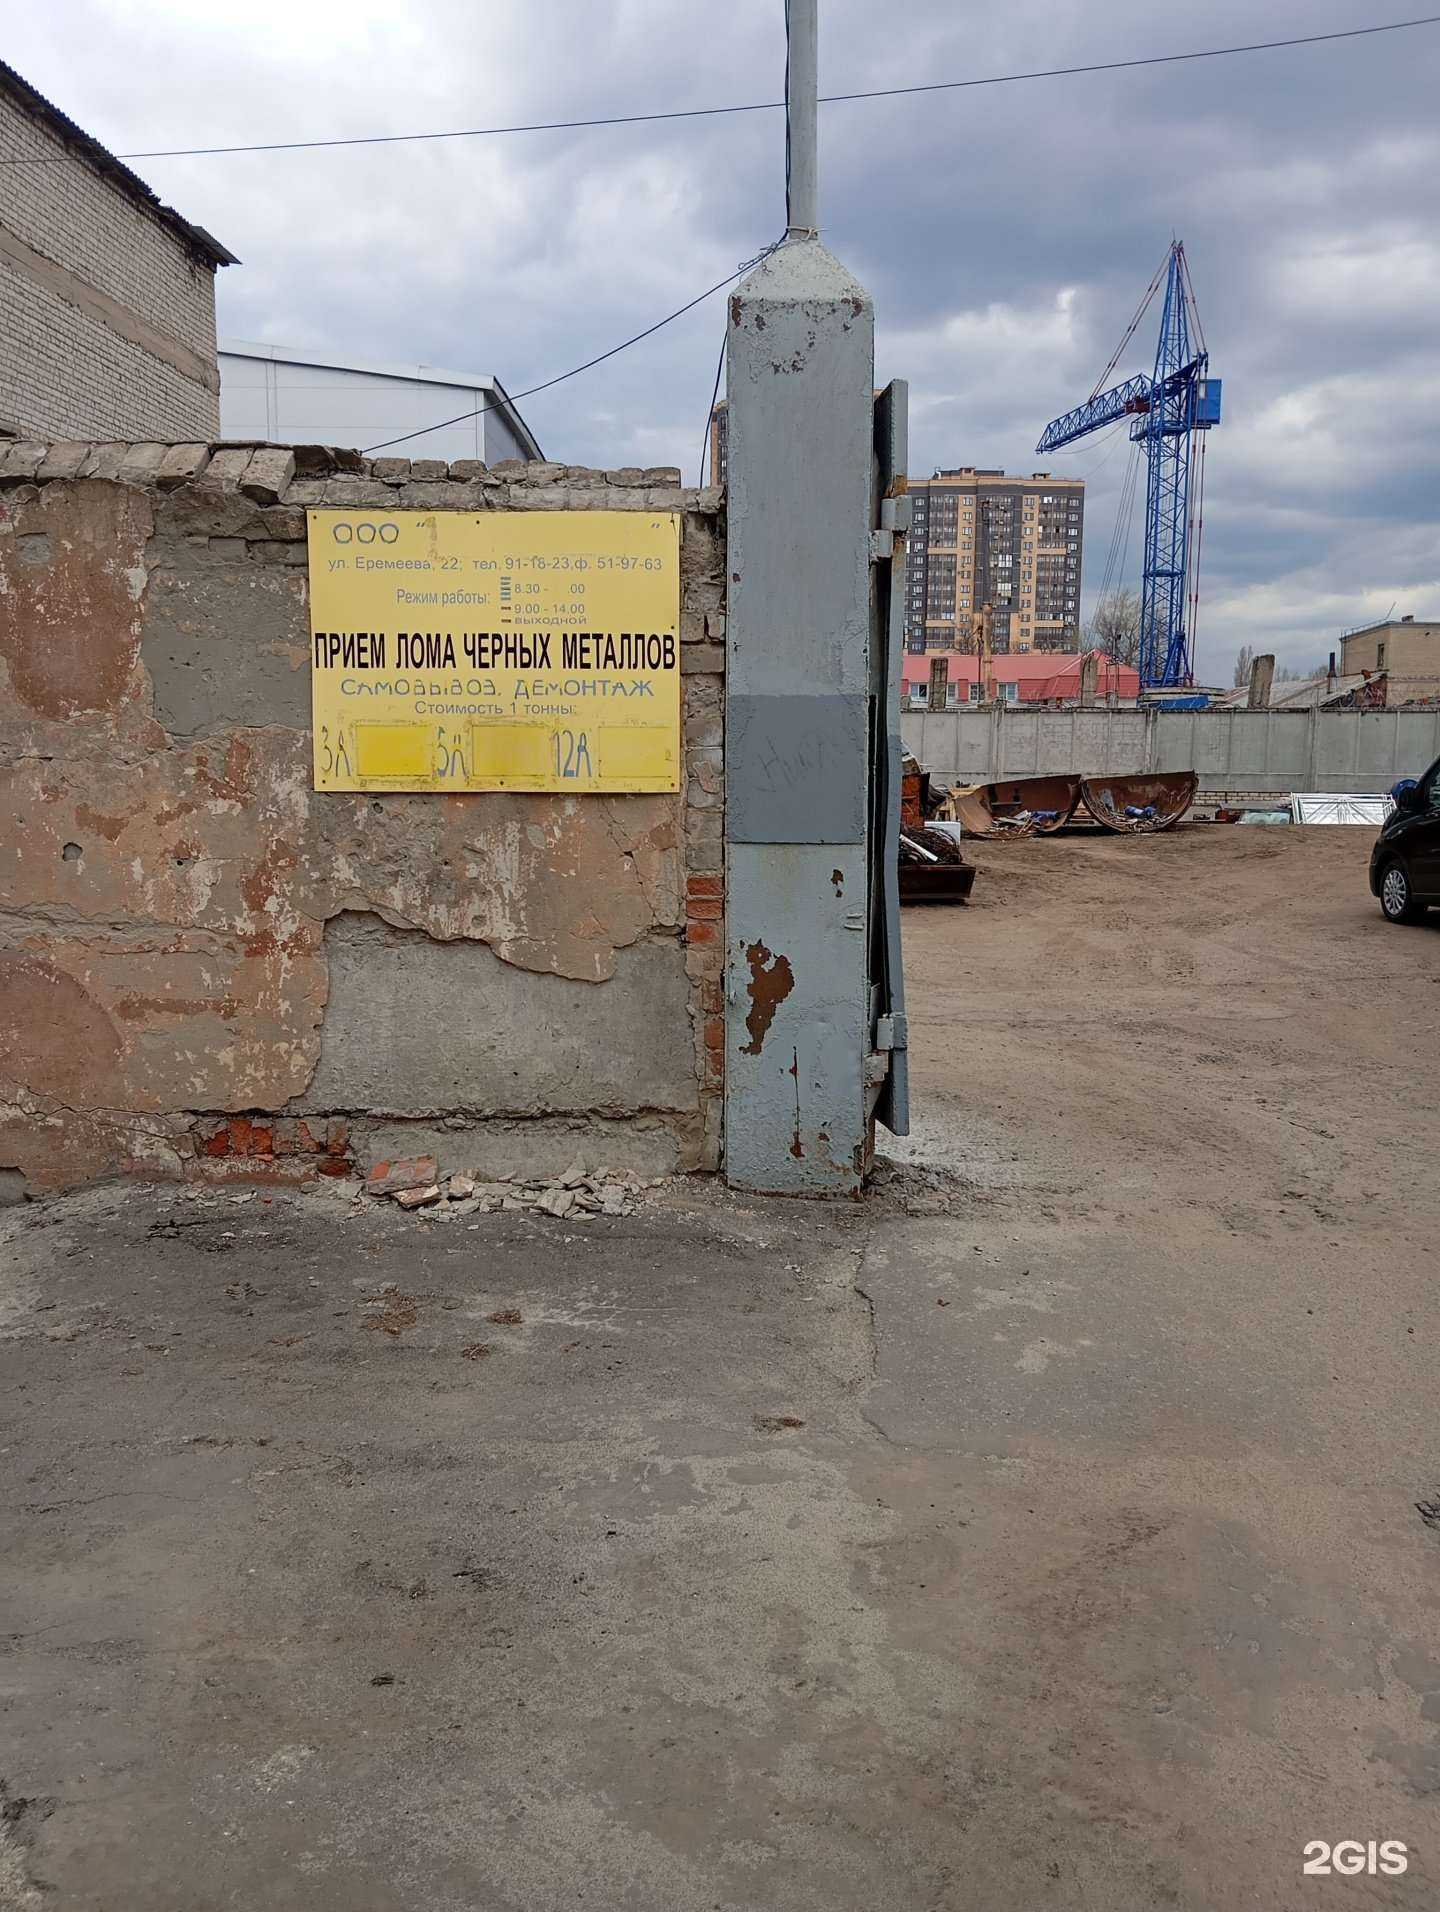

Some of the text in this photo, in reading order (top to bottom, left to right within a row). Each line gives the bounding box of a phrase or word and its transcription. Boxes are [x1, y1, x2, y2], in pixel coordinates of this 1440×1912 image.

[333, 523, 399, 544] ООО
[396, 588, 438, 604] Режим
[315, 633, 676, 670] ПРИЕМ ЛОМА ЧЕРНЫХ МЕТАЛЛОВ
[514, 680, 655, 700] ДЕМОНТАЖ
[414, 701, 504, 715] Стоимость
